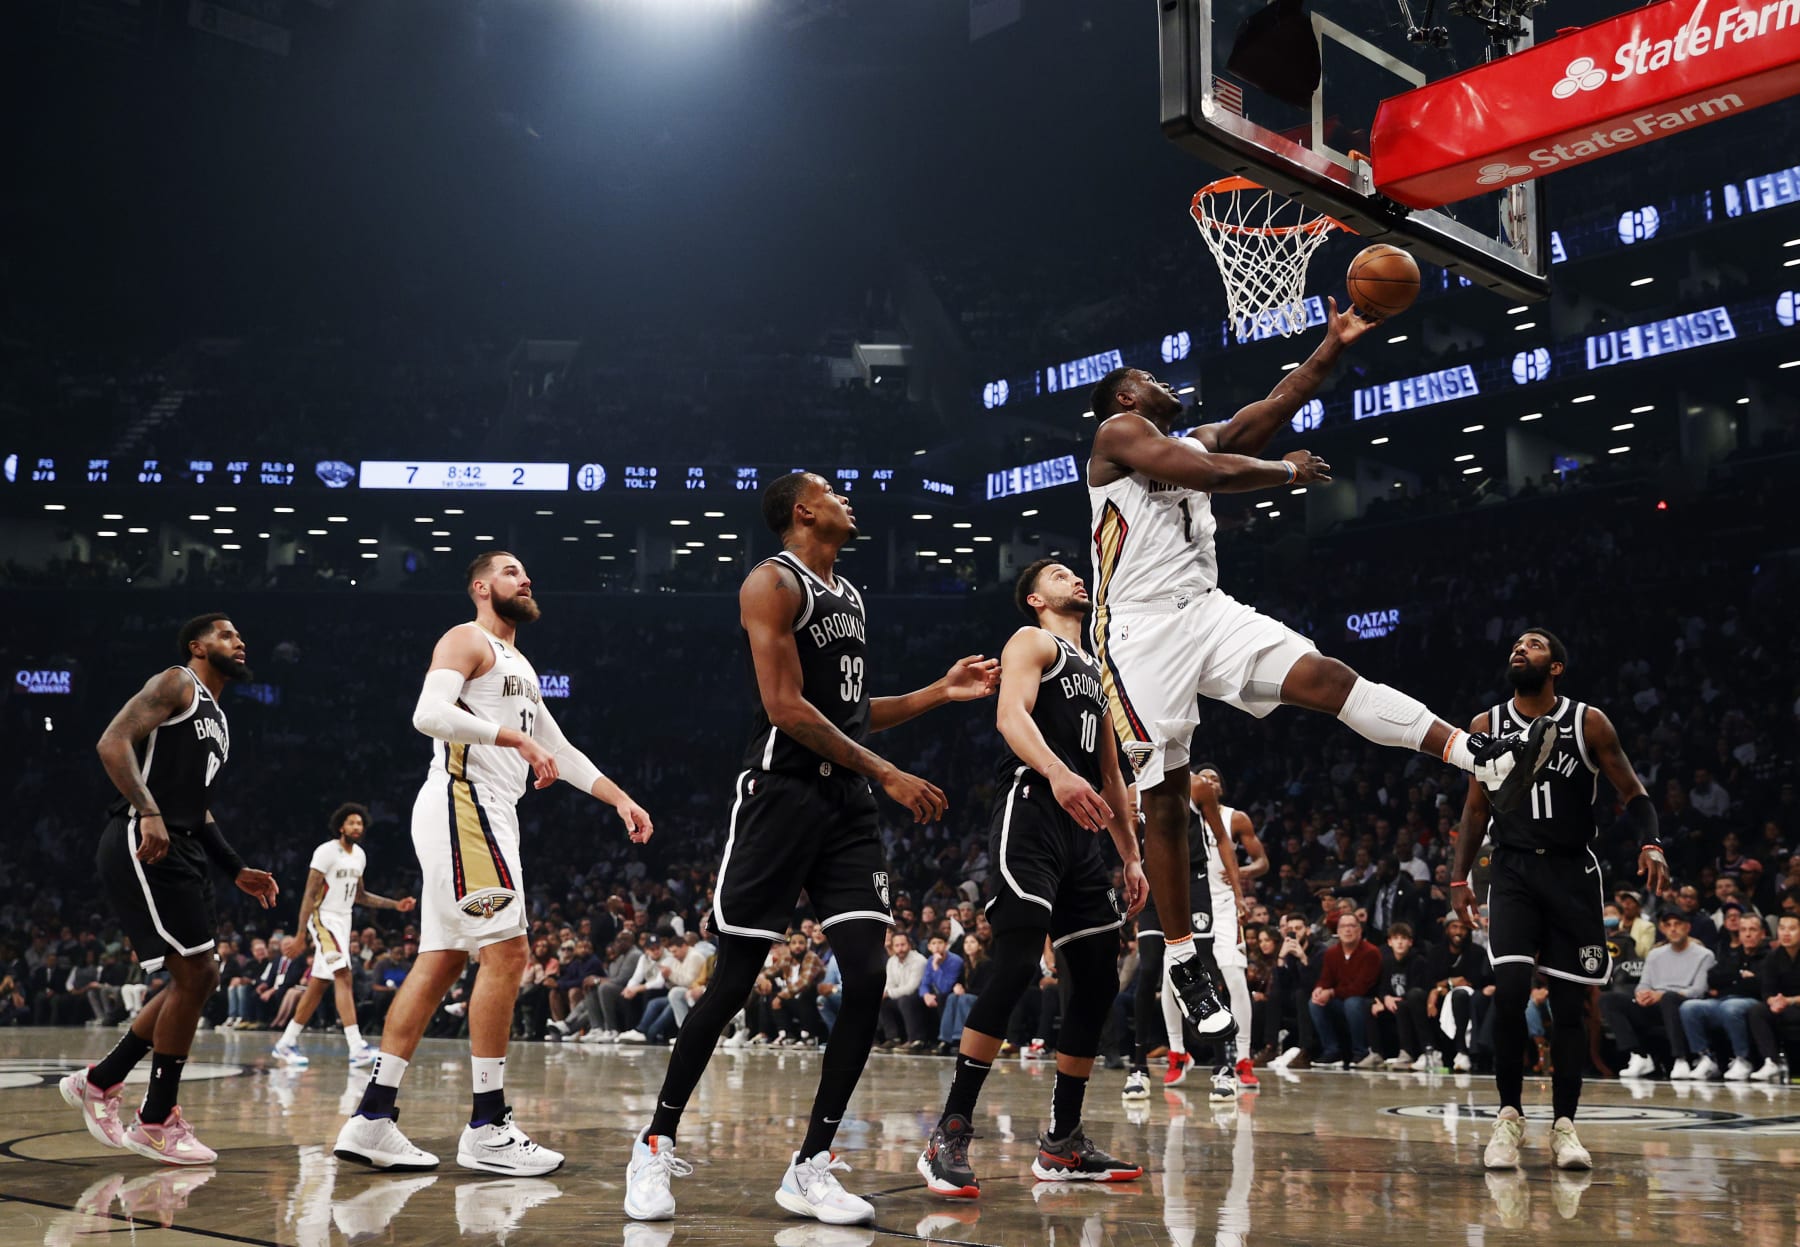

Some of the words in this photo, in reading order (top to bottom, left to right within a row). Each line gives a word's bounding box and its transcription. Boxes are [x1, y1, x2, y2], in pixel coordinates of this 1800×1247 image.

[144, 460, 158, 470] FT
[190, 461, 213, 471] REB
[227, 462, 249, 471] AST
[406, 466, 419, 484] 7
[448, 467, 481, 479] 8:42
[512, 468, 524, 485] 2
[688, 468, 703, 477] FG
[737, 468, 757, 478] 3PT
[837, 470, 859, 479] REB
[873, 470, 893, 479] AST
[456, 480, 487, 488] Quarter
[686, 480, 705, 490] 1/4
[736, 480, 757, 490] 0/1
[844, 482, 851, 491] 2
[940, 484, 954, 496] PM
[1178, 497, 1192, 543] 1
[1347, 609, 1399, 632] QATAR
[16, 670, 70, 687] QATAR
[539, 675, 570, 689] TAR
[840, 654, 864, 703] 33
[520, 708, 533, 737] 17
[1080, 709, 1097, 753] 10
[1531, 781, 1553, 819] 11
[1581, 947, 1603, 959] NETS
